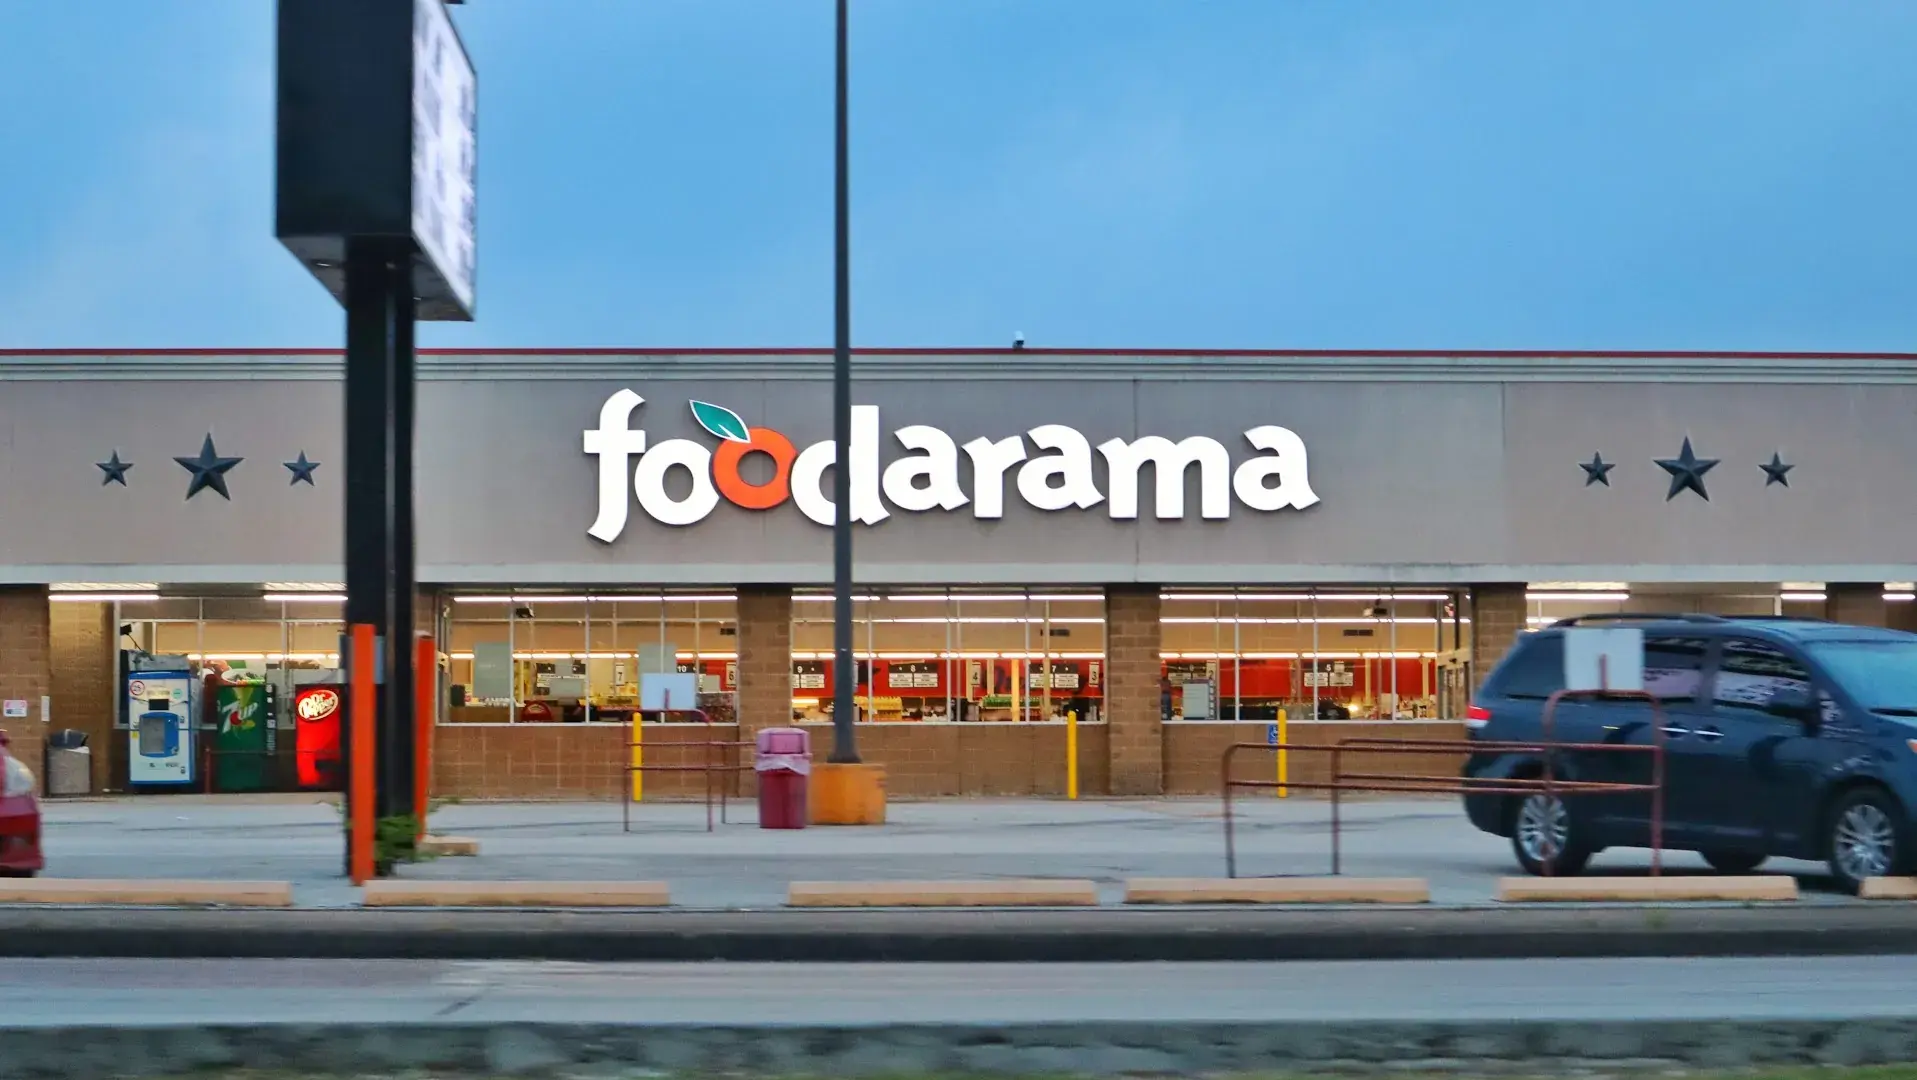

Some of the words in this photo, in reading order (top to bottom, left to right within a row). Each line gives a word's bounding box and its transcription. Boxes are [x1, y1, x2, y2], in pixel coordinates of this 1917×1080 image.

[582, 387, 1321, 544] foodarama
[677, 665, 687, 673] 10
[797, 665, 803, 674] 9
[1051, 665, 1057, 673] 7
